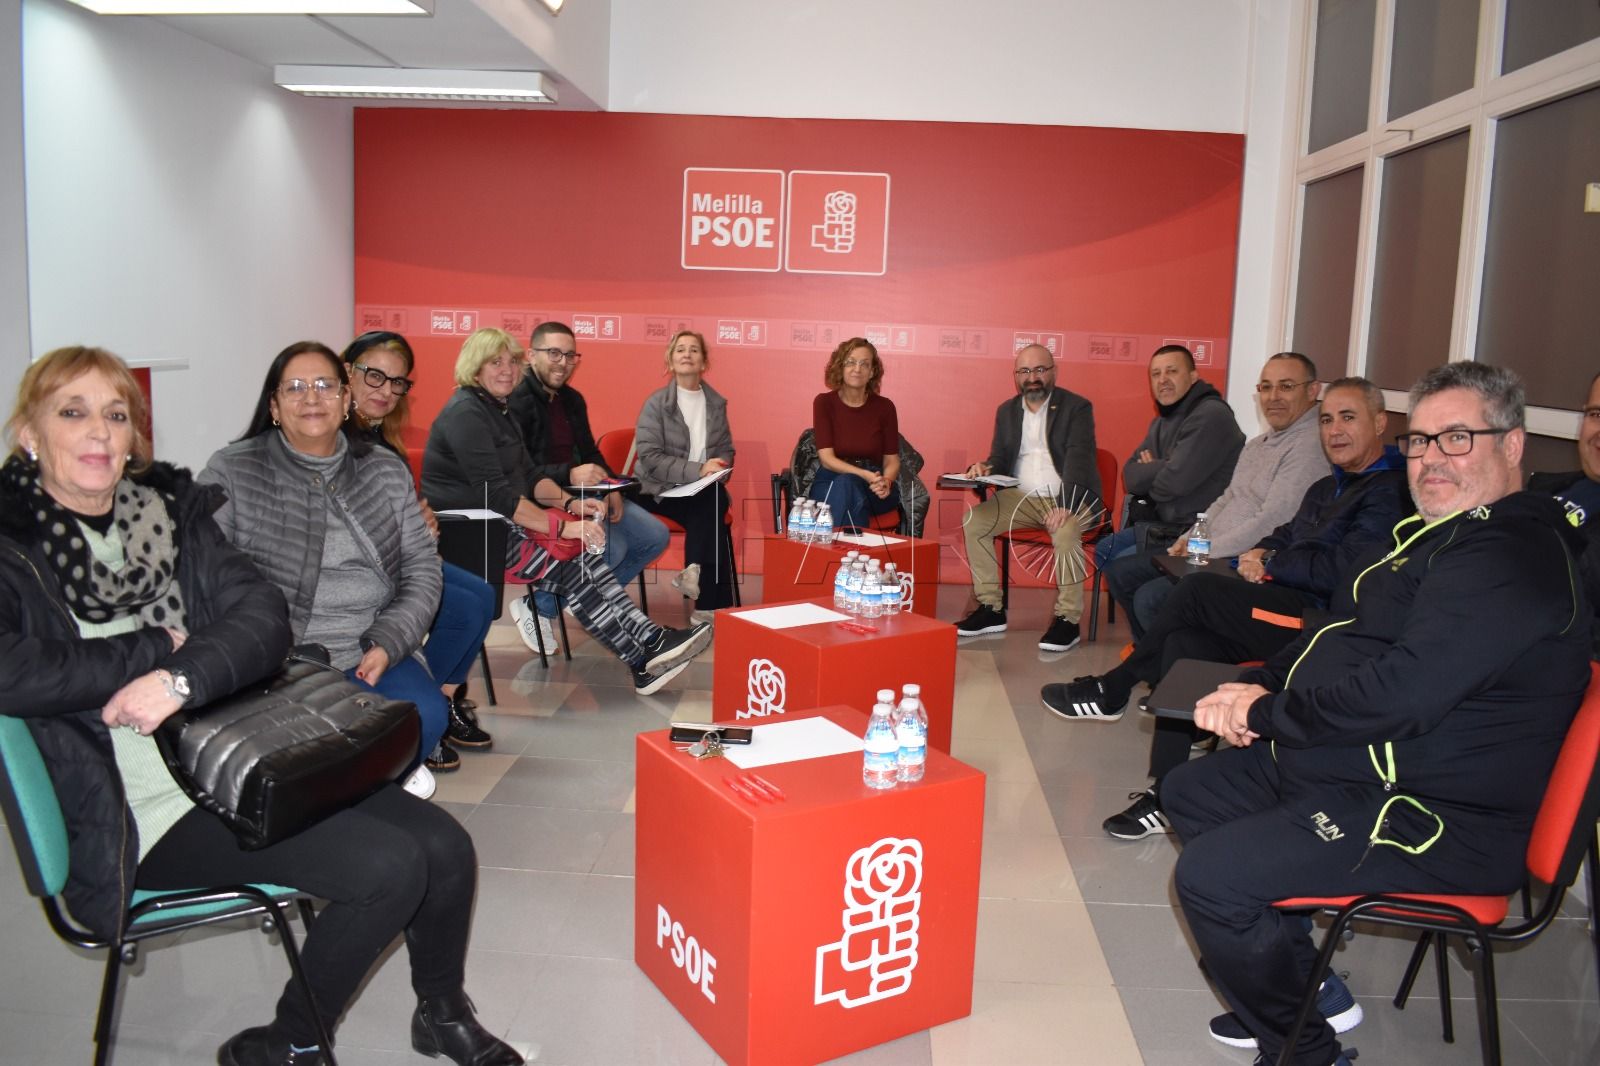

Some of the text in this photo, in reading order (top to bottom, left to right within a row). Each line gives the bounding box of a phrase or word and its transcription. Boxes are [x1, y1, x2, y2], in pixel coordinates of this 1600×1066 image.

[692, 193, 763, 214] Melilla
[690, 215, 775, 248] PSOE
[432, 321, 454, 330] PSOE
[574, 326, 595, 335] PSOE
[719, 331, 741, 340] PSOE
[1311, 811, 1345, 840] RUN
[657, 904, 717, 1004] PSOE
